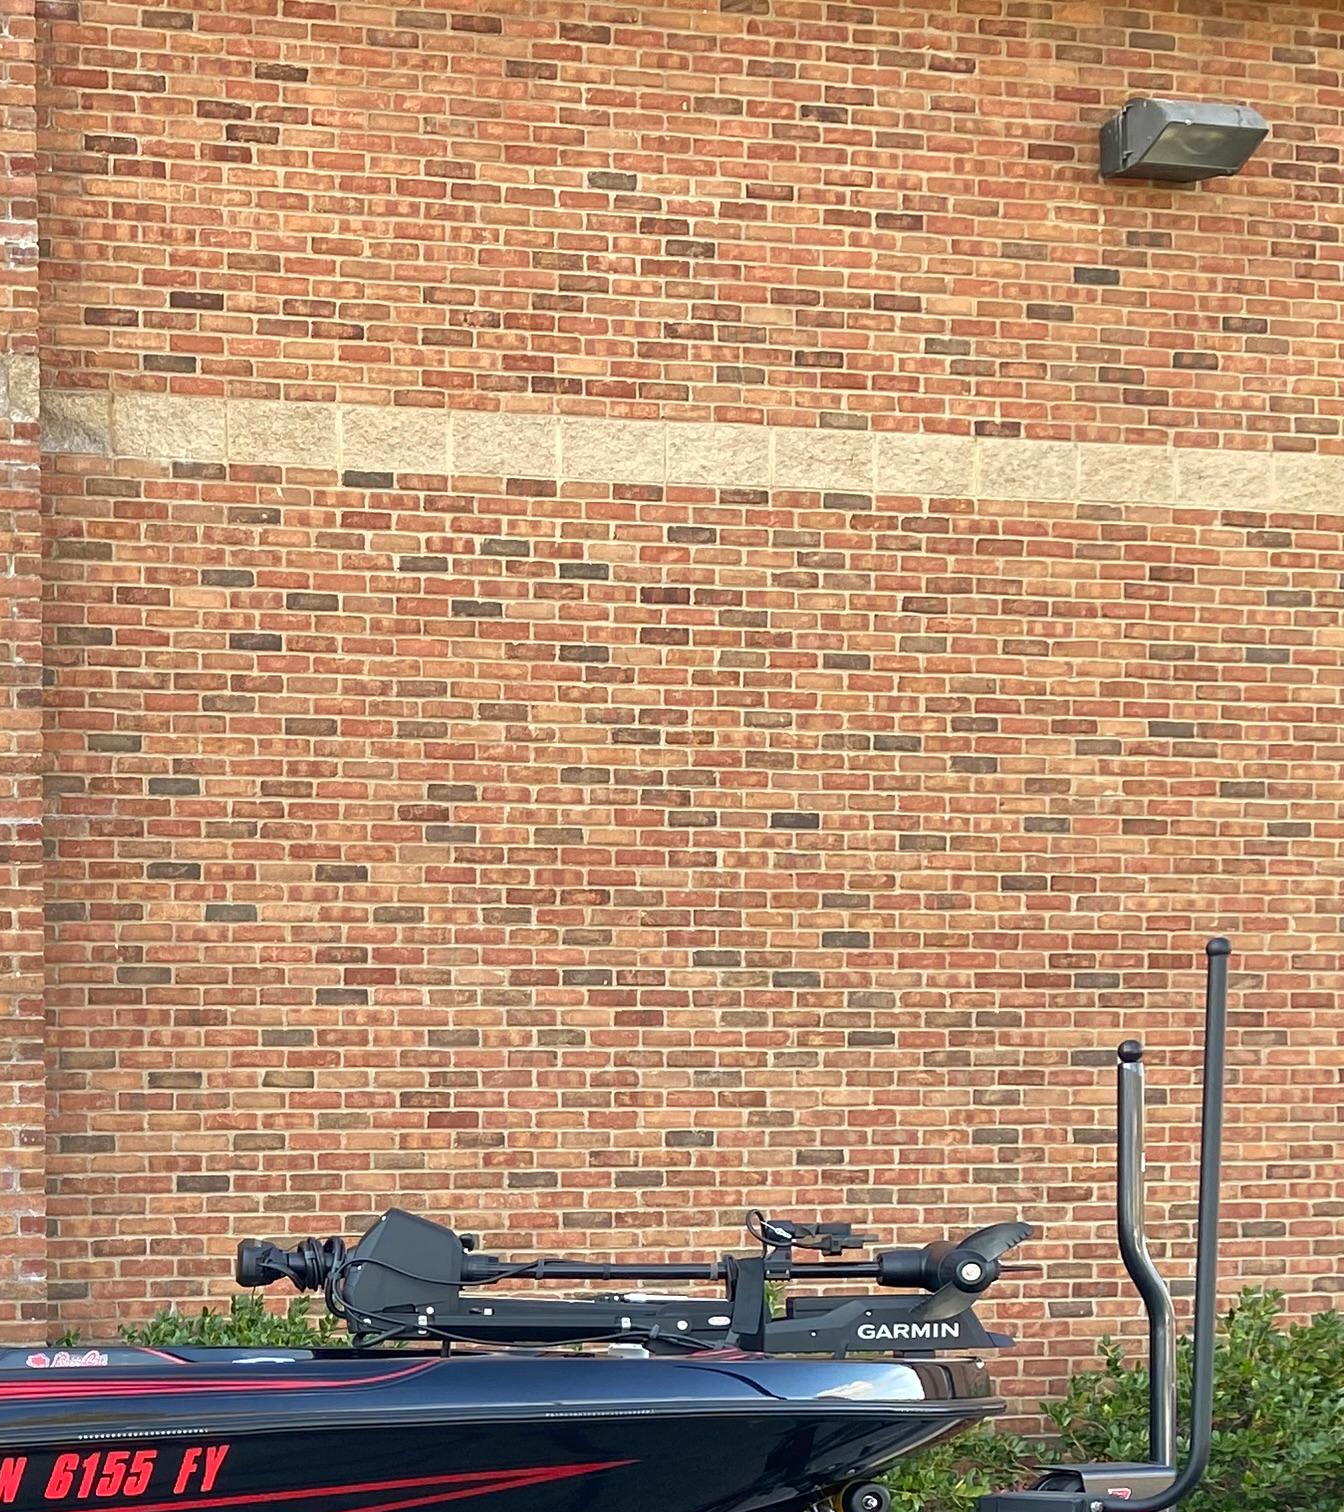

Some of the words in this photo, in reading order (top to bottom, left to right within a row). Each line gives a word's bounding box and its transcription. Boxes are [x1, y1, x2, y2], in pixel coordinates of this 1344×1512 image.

[857, 1322, 960, 1340] GARMIN
[44, 1450, 158, 1499] 6155
[173, 1444, 230, 1495] FY
